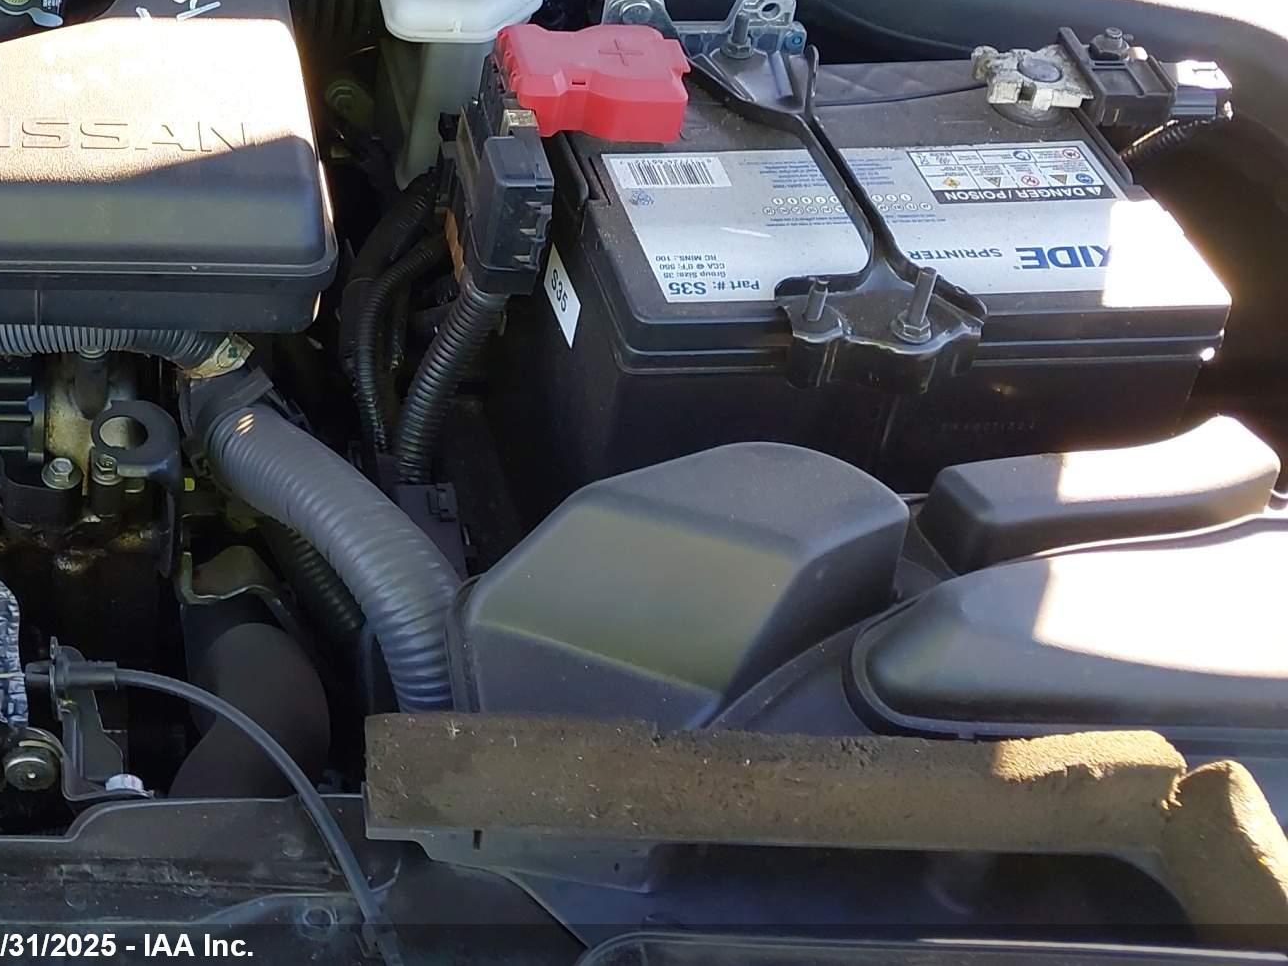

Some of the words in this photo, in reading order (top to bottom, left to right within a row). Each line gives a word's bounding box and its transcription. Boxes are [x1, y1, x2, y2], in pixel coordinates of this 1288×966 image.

[943, 189, 1007, 201] POISON
[1015, 186, 1086, 199] DANGER
[910, 248, 1003, 260] SPRINTER
[1015, 245, 1112, 269] XIDE
[551, 268, 568, 312] S35
[668, 281, 707, 295] S35
[712, 281, 725, 290] #:
[730, 280, 760, 290] Part
